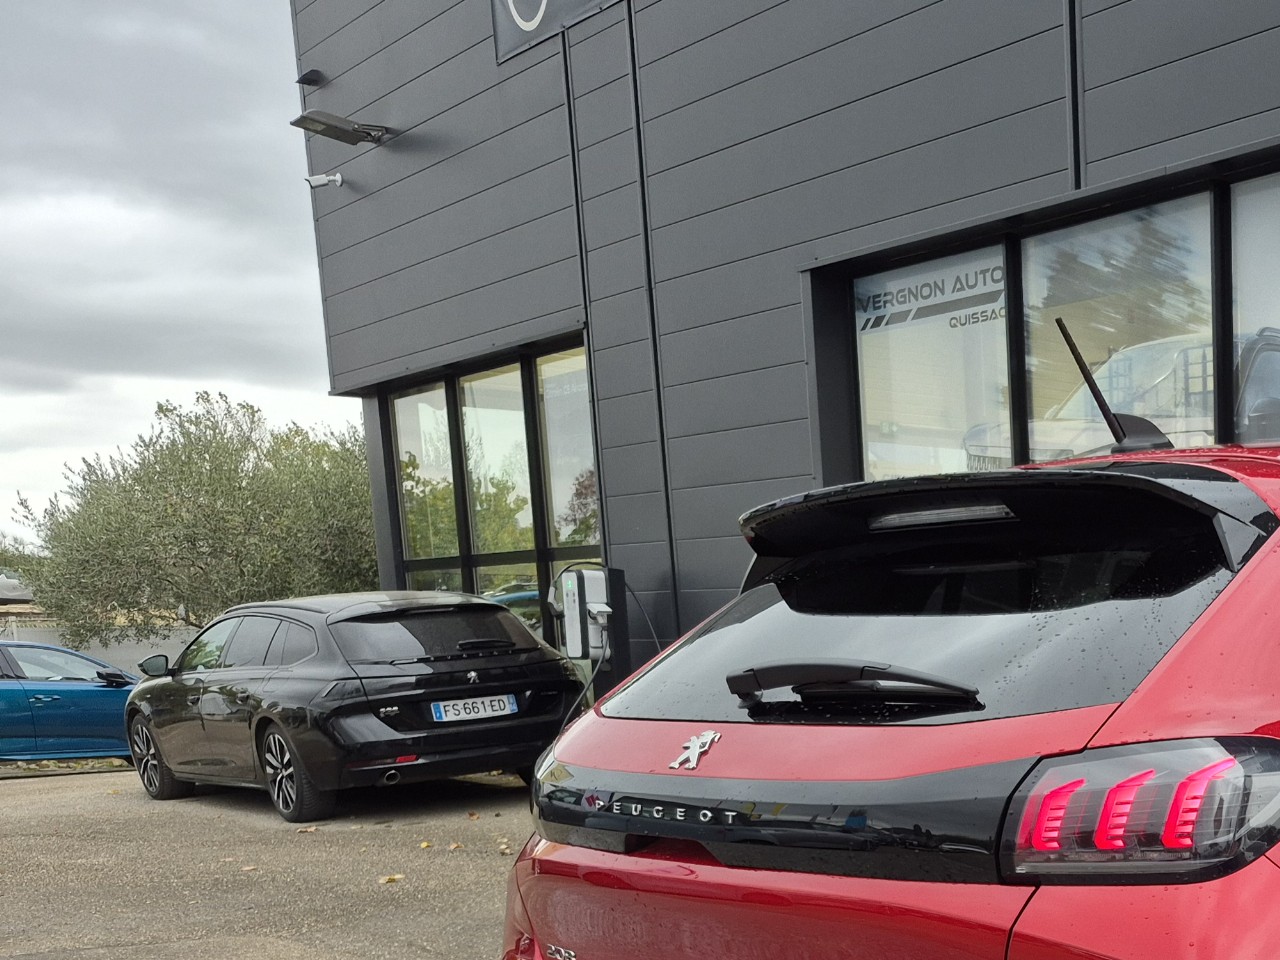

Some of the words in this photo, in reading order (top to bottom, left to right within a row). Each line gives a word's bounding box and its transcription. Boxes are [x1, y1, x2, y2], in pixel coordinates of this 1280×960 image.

[857, 278, 946, 314] VERGNON
[951, 265, 1005, 294] AUTO
[442, 699, 507, 718] FS-661-ED
[595, 800, 737, 825] PEUGEOT
